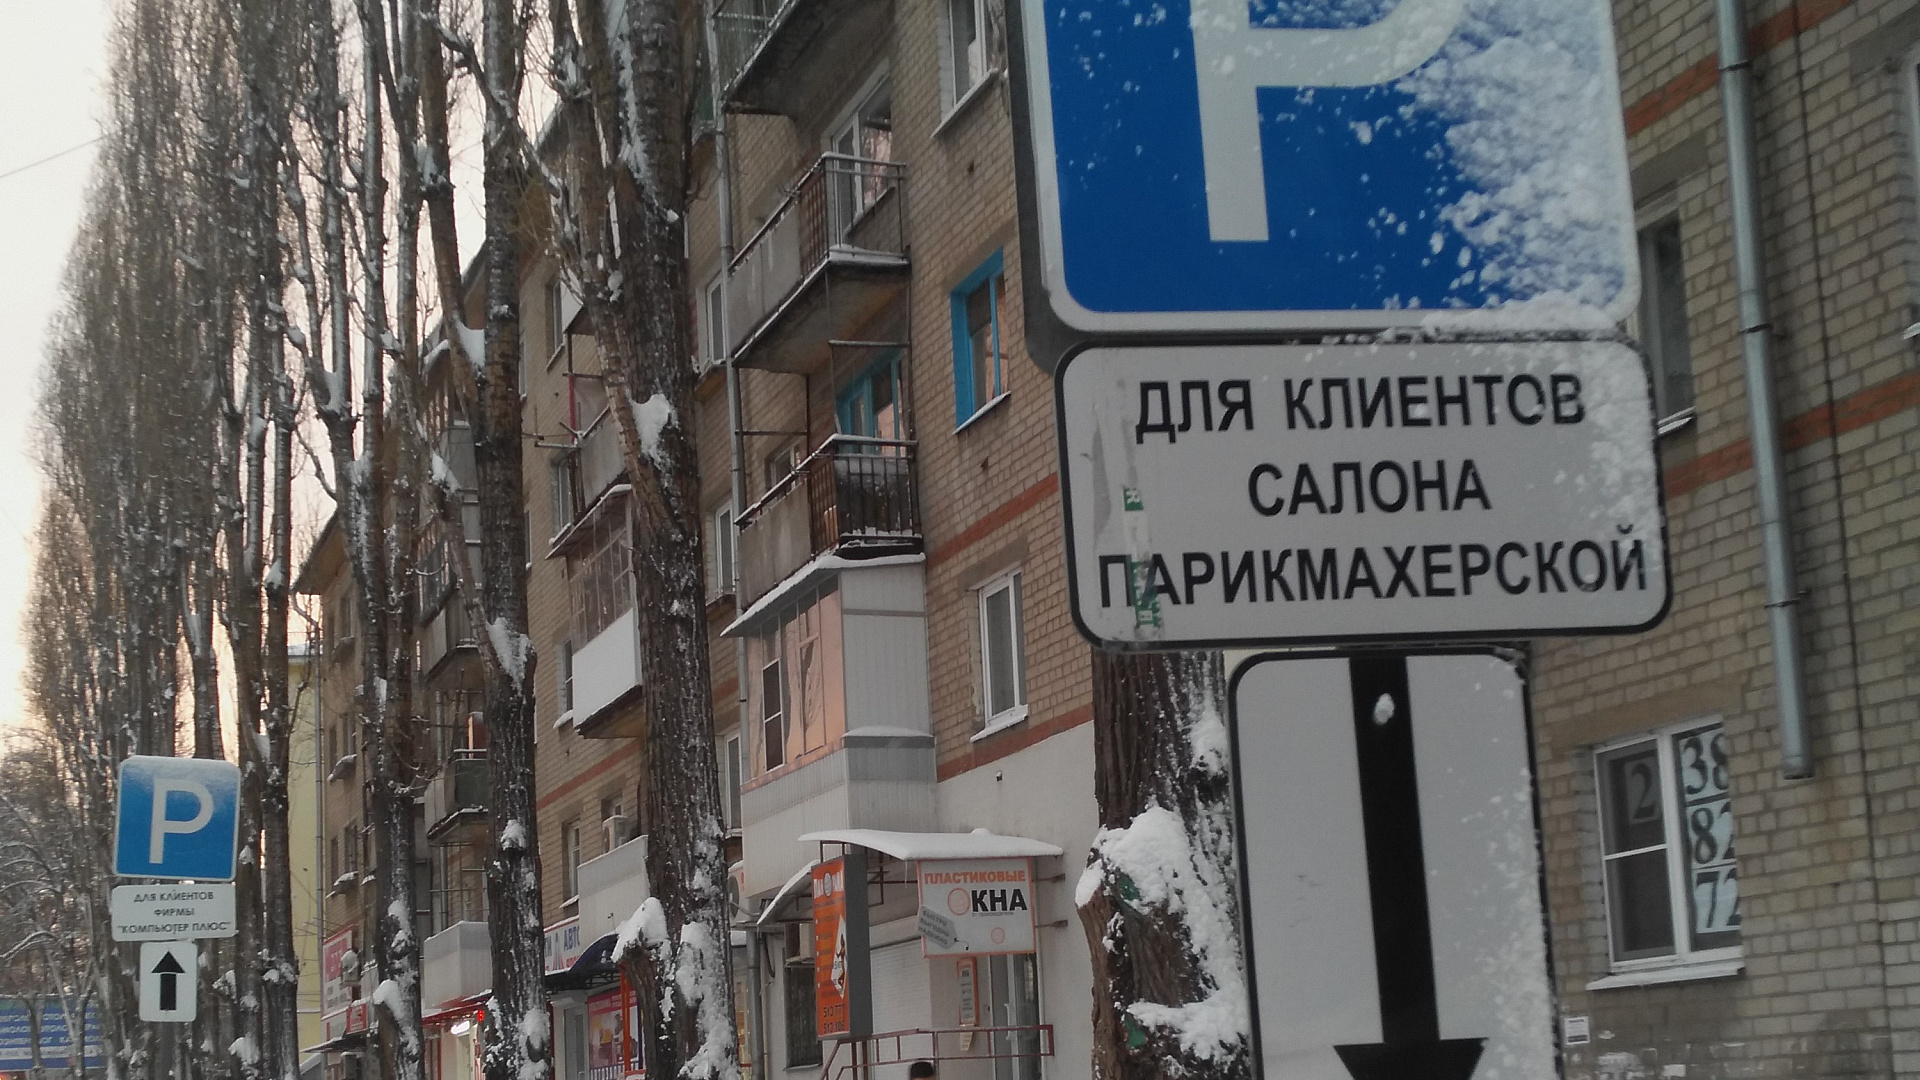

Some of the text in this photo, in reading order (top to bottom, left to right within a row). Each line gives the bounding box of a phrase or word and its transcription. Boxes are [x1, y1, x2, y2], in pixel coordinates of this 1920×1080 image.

[1135, 373, 1586, 444] ДЛЯ КЛИЕНТОВ
[1248, 459, 1492, 517] САЛОНА
[1099, 524, 1648, 607] ПАРИКМАХЕРСКОЙ
[149, 778, 214, 864] P
[133, 890, 214, 903] ДЛЯ КЛИЕНТОВ
[925, 870, 1025, 884] ПЛАСТИКОВЫЕ
[153, 907, 195, 918] ФИРМЫ
